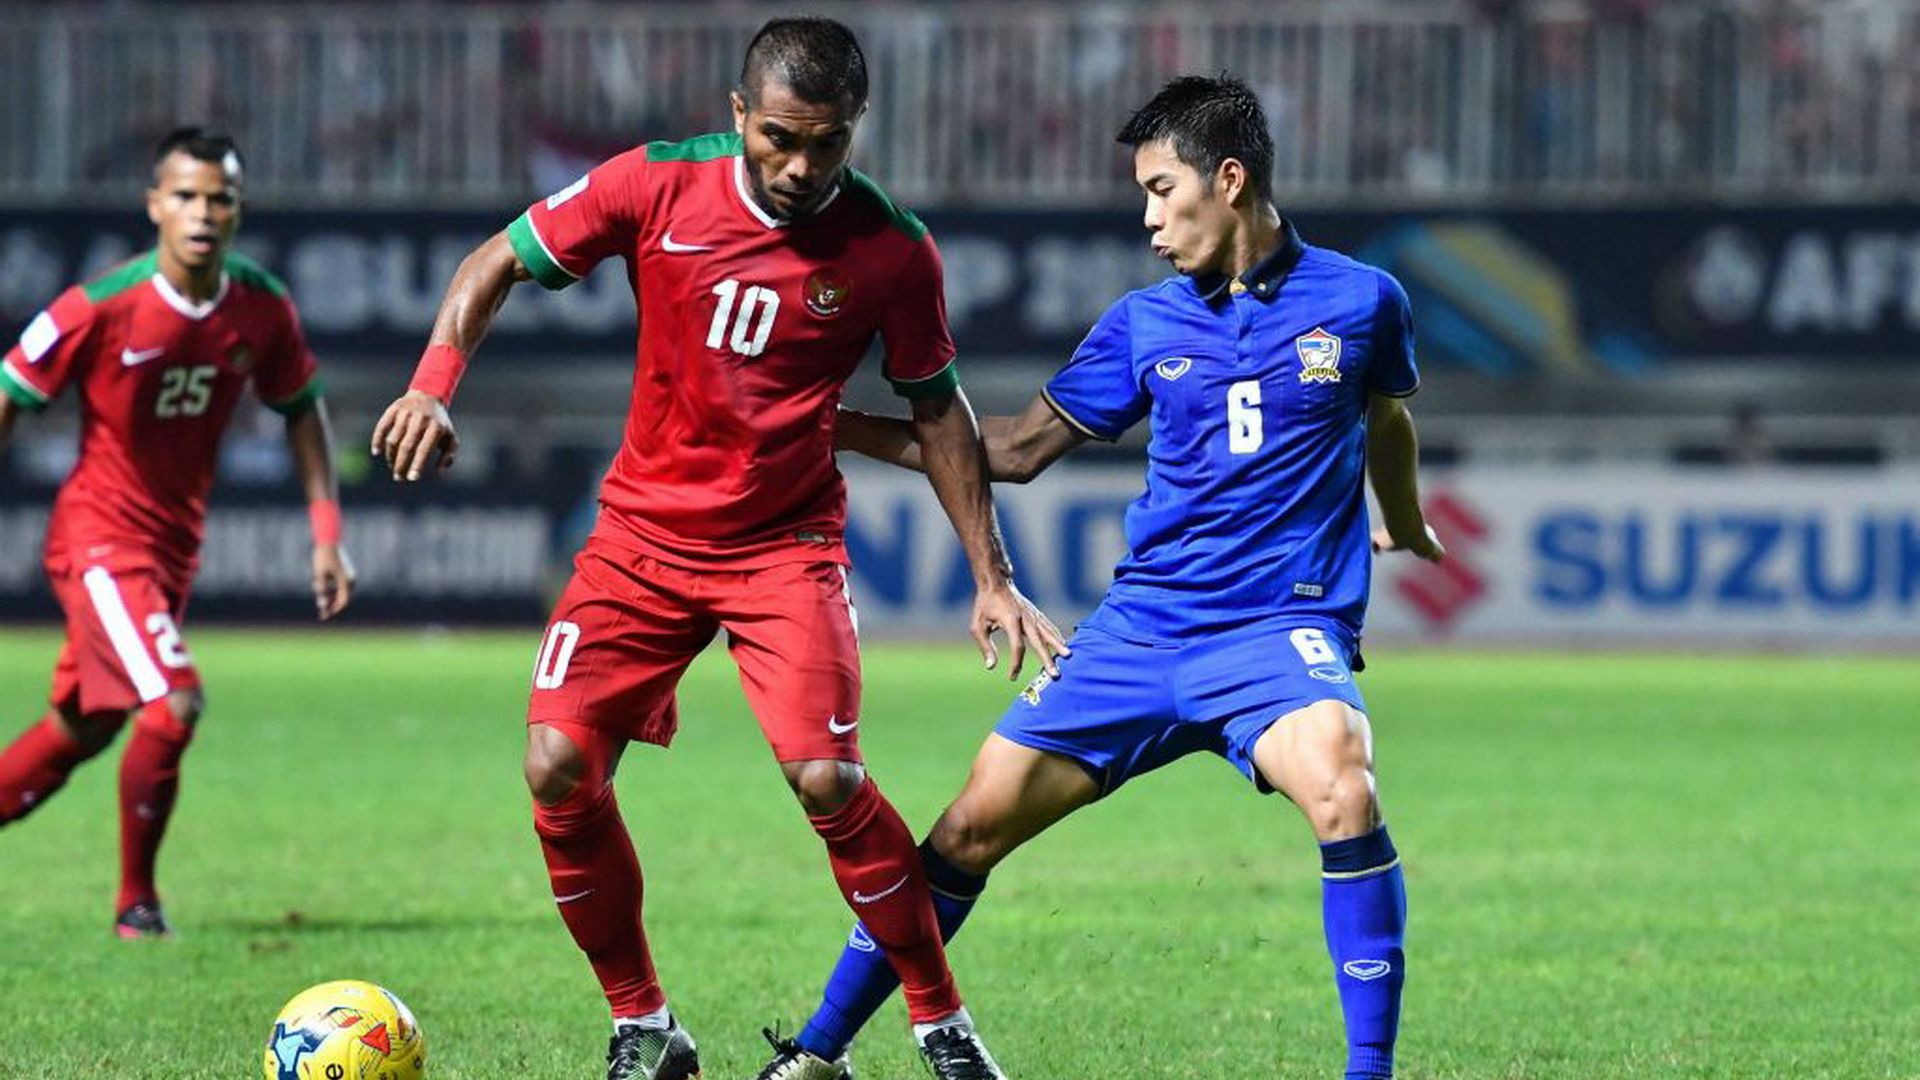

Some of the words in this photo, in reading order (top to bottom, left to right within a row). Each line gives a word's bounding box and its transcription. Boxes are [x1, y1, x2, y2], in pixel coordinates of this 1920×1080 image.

[1767, 234, 1920, 327] AF
[706, 279, 780, 357] 10
[156, 365, 218, 417] 25
[1227, 380, 1263, 454] 6
[534, 620, 580, 690] 0
[1290, 628, 1337, 665] 6
